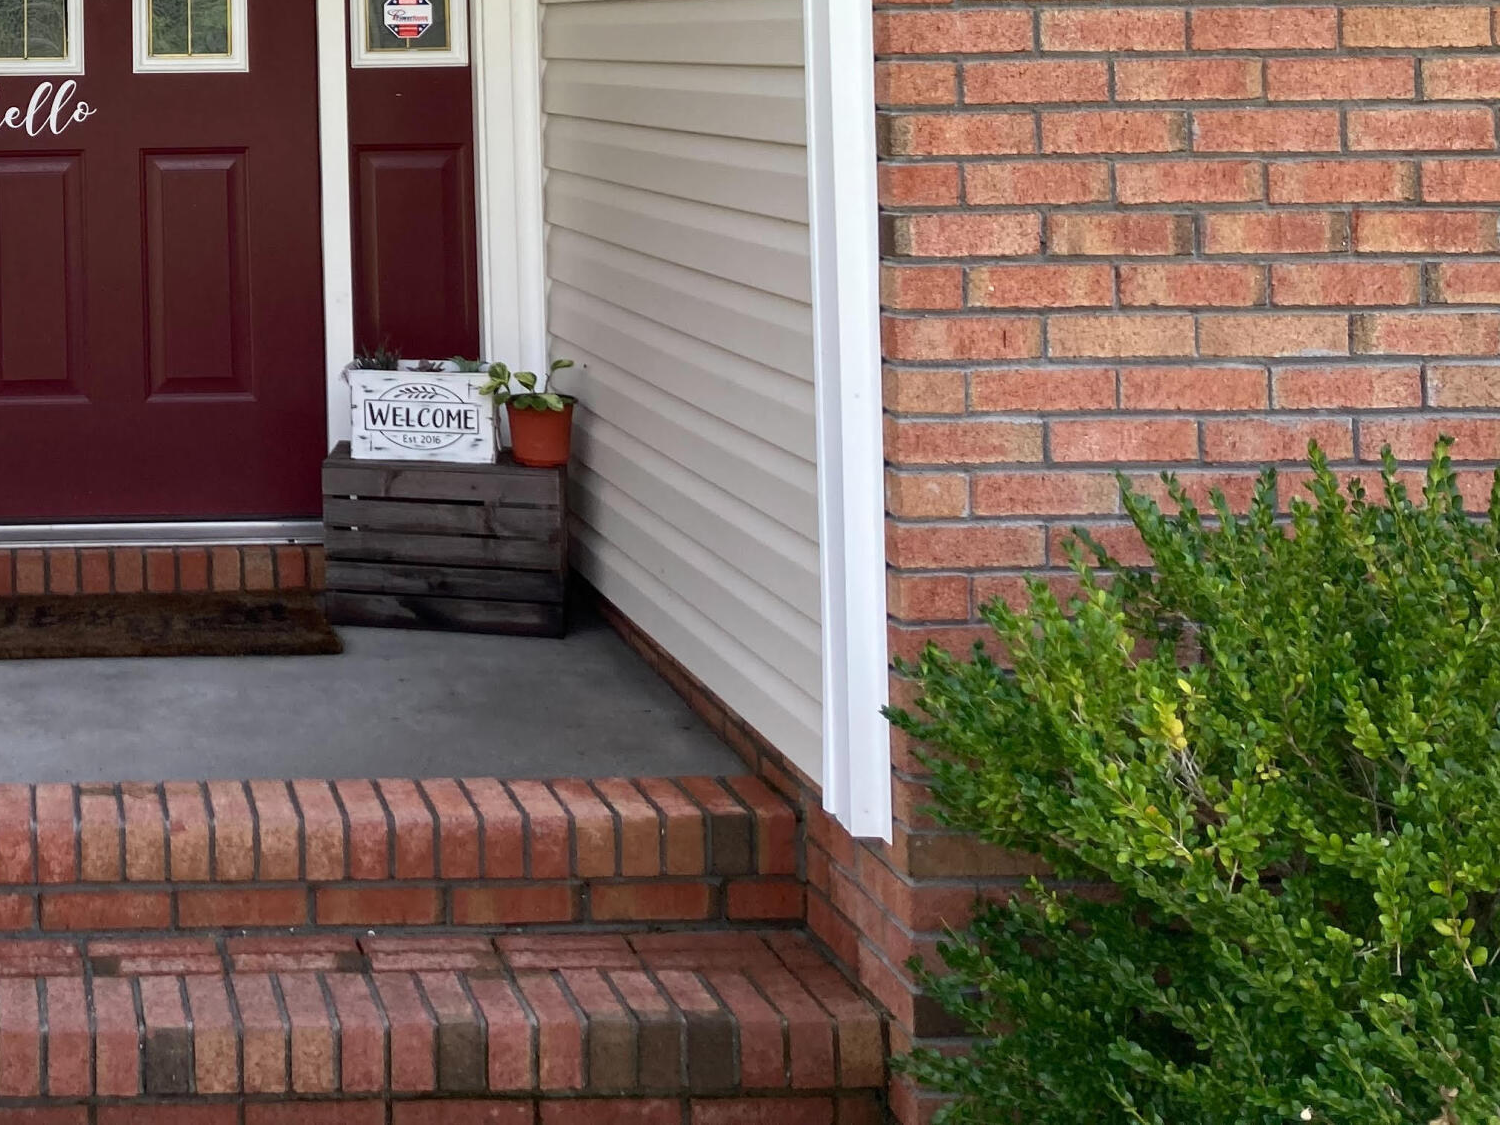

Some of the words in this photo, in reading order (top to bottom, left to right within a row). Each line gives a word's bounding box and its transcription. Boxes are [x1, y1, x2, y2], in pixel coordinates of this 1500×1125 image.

[368, 402, 476, 430] WELCOME
[402, 434, 418, 444] Est
[420, 435, 442, 445] 2016
